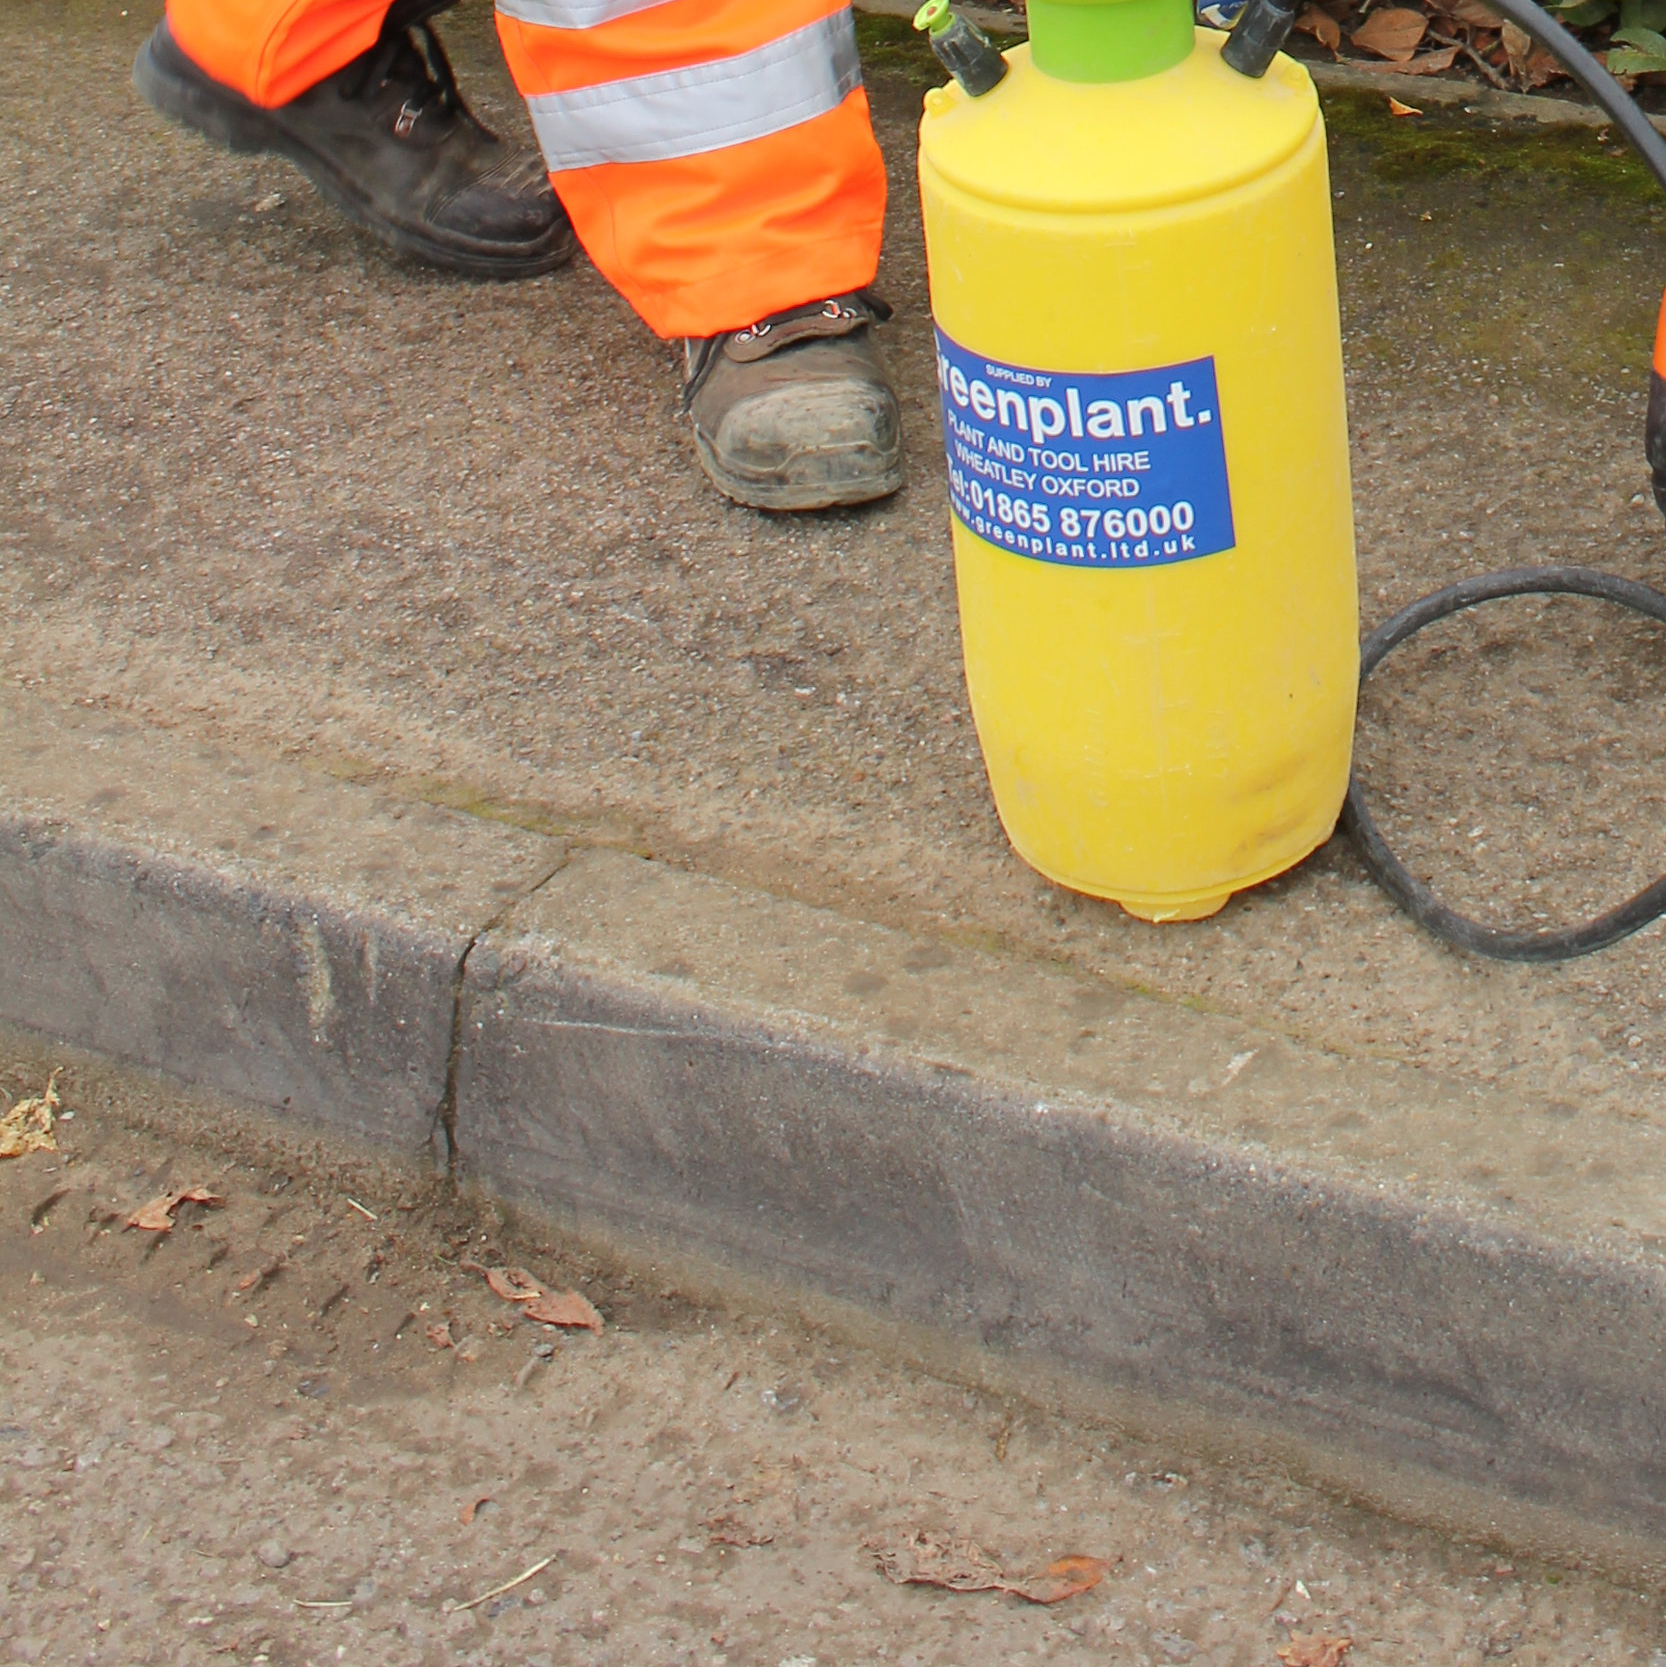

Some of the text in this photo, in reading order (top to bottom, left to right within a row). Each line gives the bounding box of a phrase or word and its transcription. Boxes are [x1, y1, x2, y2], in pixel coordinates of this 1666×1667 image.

[935, 330, 1212, 444] reenplant.
[985, 363, 1052, 388] SUPPLIED BY
[948, 408, 1151, 473] PLANT AND TOOL HIRE
[954, 438, 1140, 499] WHEATLEY OXFORD
[1059, 501, 1195, 539] 876000
